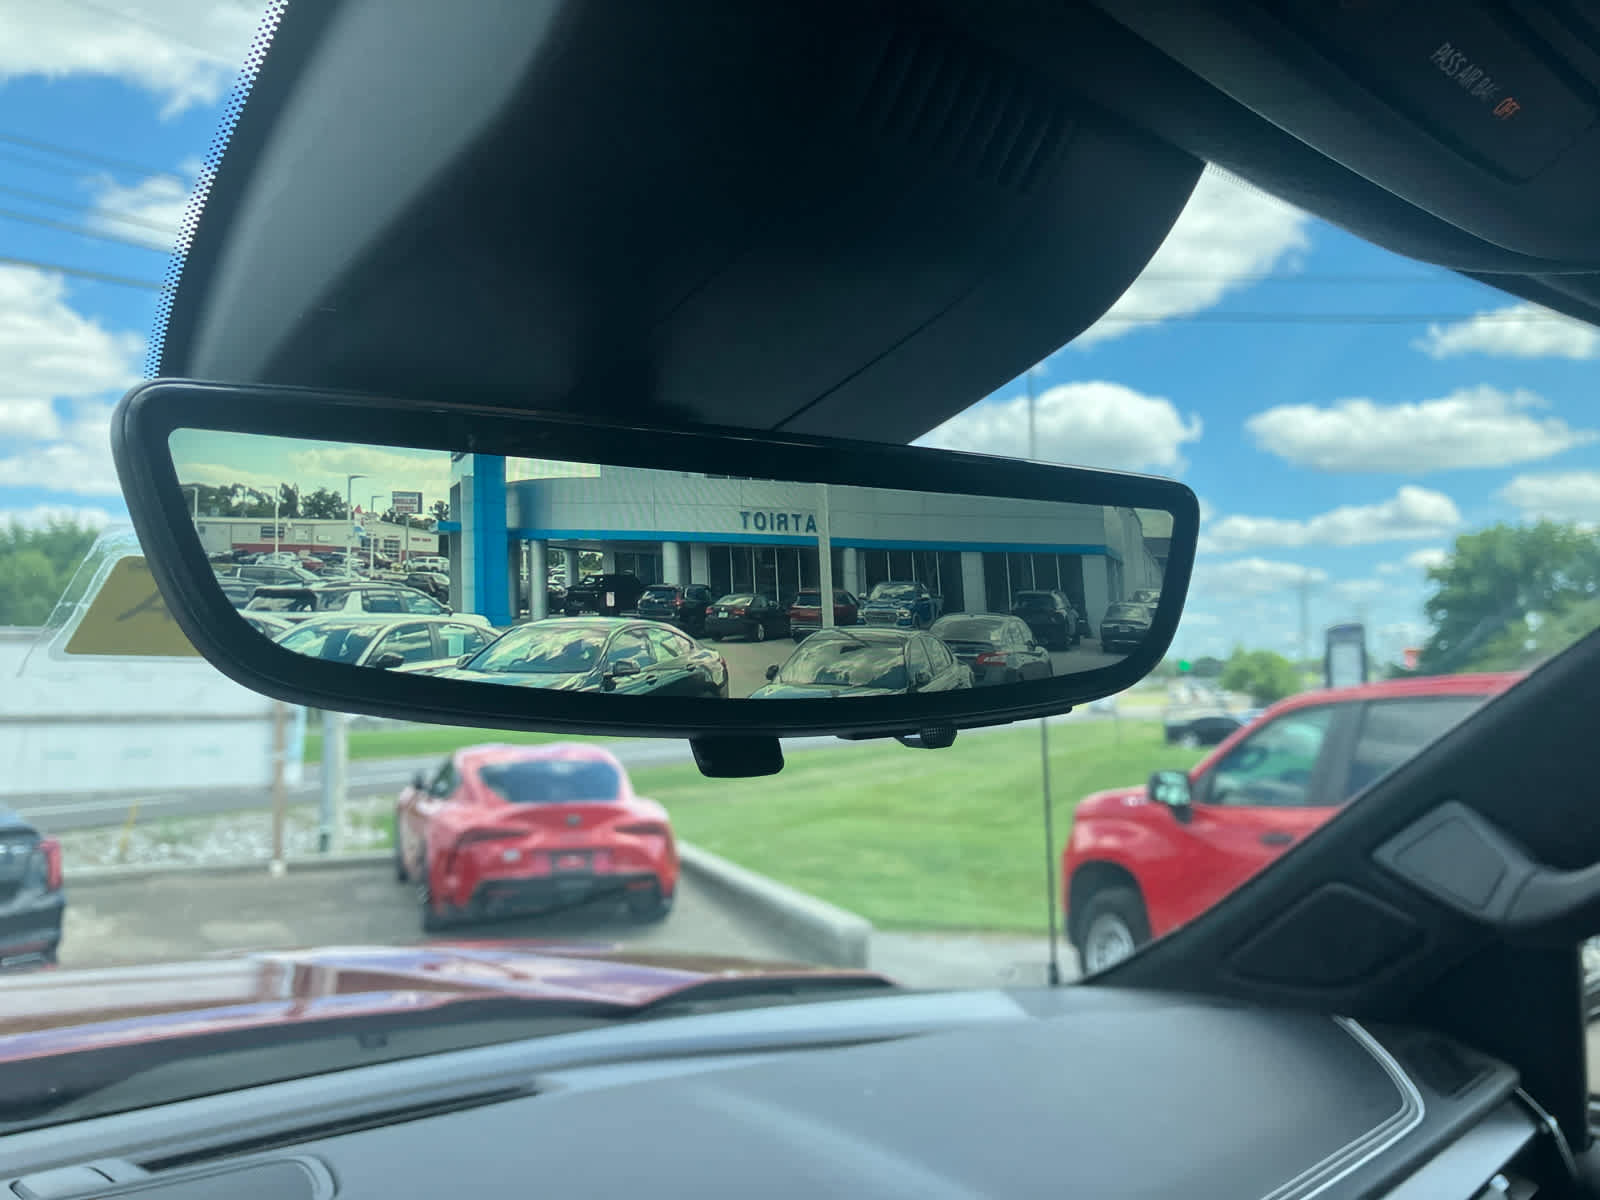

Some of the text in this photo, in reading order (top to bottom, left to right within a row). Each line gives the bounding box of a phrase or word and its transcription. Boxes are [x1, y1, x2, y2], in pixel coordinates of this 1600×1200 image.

[1429, 42, 1467, 77] PASS
[1455, 63, 1483, 89] AIR
[1493, 97, 1520, 120] OFF
